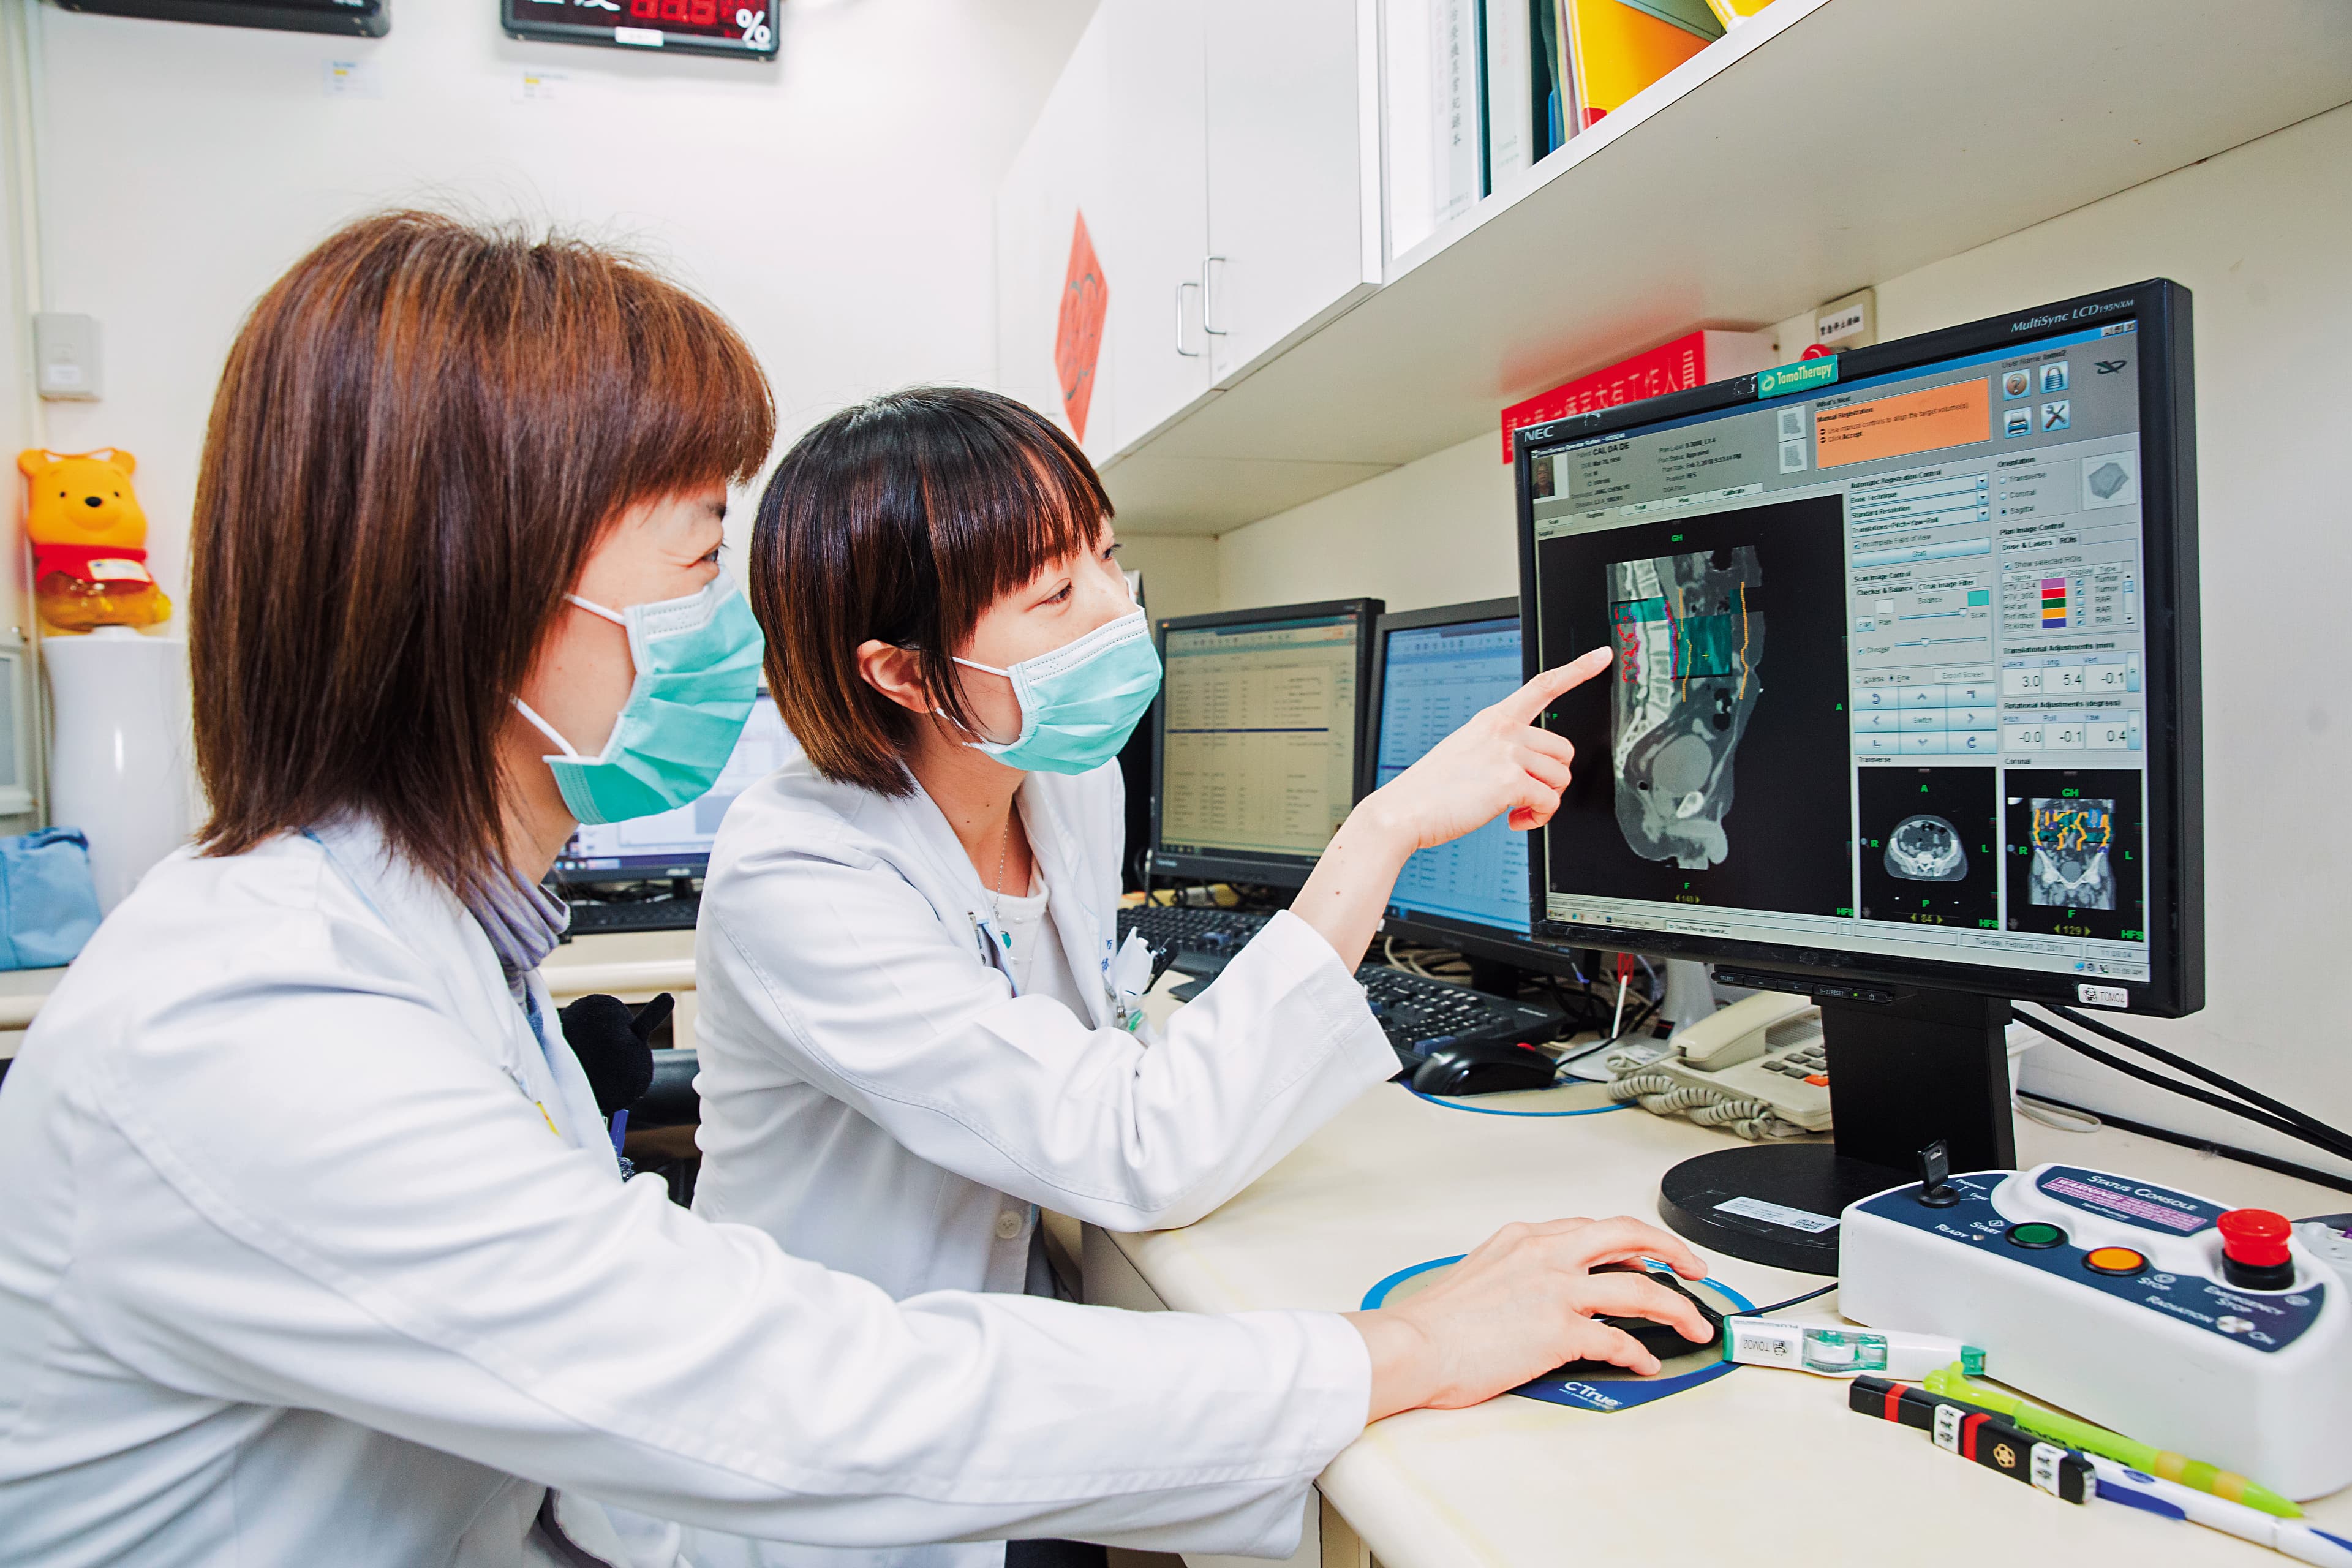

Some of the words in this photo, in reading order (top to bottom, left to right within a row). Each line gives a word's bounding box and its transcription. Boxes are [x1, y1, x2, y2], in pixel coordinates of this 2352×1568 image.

[2011, 313, 2068, 333] MultiSync
[2002, 360, 2018, 369] User
[1777, 364, 1832, 385] TomoTherapy
[1817, 413, 1838, 423] Manual
[1839, 406, 1874, 418] Registration
[1893, 415, 1908, 424] align
[1524, 426, 1554, 442] NEC
[1997, 457, 2035, 467] Orientation
[1850, 478, 1880, 489] Automatic
[1881, 473, 1917, 484] Registration
[1918, 469, 1942, 478] Control
[2009, 472, 2047, 483] Transverse
[1868, 492, 1898, 502] Technique
[2009, 489, 2037, 499] Coronal
[1851, 510, 1879, 519] Standard
[1880, 505, 1911, 515] Resolution
[2010, 505, 2035, 515] Sagittal
[1999, 527, 2015, 536] Plan
[2016, 526, 2037, 535] Image
[2038, 522, 2065, 531] Control
[2002, 543, 2020, 551] Dose
[2029, 540, 2053, 548] Lasers
[2035, 558, 2063, 567] selected
[2067, 567, 2094, 576] Display
[2003, 646, 2046, 654] Translational
[2048, 643, 2094, 652] Adjustments
[2095, 641, 2115, 650] (mm)
[2022, 675, 2041, 687] 3.0
[2063, 673, 2082, 686] 5.4
[2100, 671, 2125, 684] -0.1
[2019, 731, 2042, 743] -0.0
[2059, 730, 2082, 742] -0.1
[2106, 729, 2127, 742] 0.4
[1920, 784, 1929, 793] A
[2062, 788, 2079, 797] GH
[1982, 844, 1989, 853] L
[2019, 846, 2028, 854] R
[2125, 851, 2133, 860] L
[1836, 907, 1854, 916] HFS
[1978, 919, 1998, 929] HFS
[2062, 925, 2082, 935] 129
[2121, 930, 2143, 940] HFS
[2099, 991, 2125, 1003] TOMO2
[1956, 1178, 1988, 1190] PROGRAM
[1970, 1192, 1989, 1201] TREAT
[2087, 1175, 2132, 1192] STATUS
[2134, 1188, 2198, 1212] CONSOLE
[1935, 1224, 1970, 1238] READY
[1969, 1221, 2002, 1235] START
[2136, 1277, 2171, 1291] STOP
[2145, 1295, 2215, 1323] RADIATION
[1743, 1338, 1770, 1352] TOMO2
[1564, 1381, 1619, 1407] CTrue
